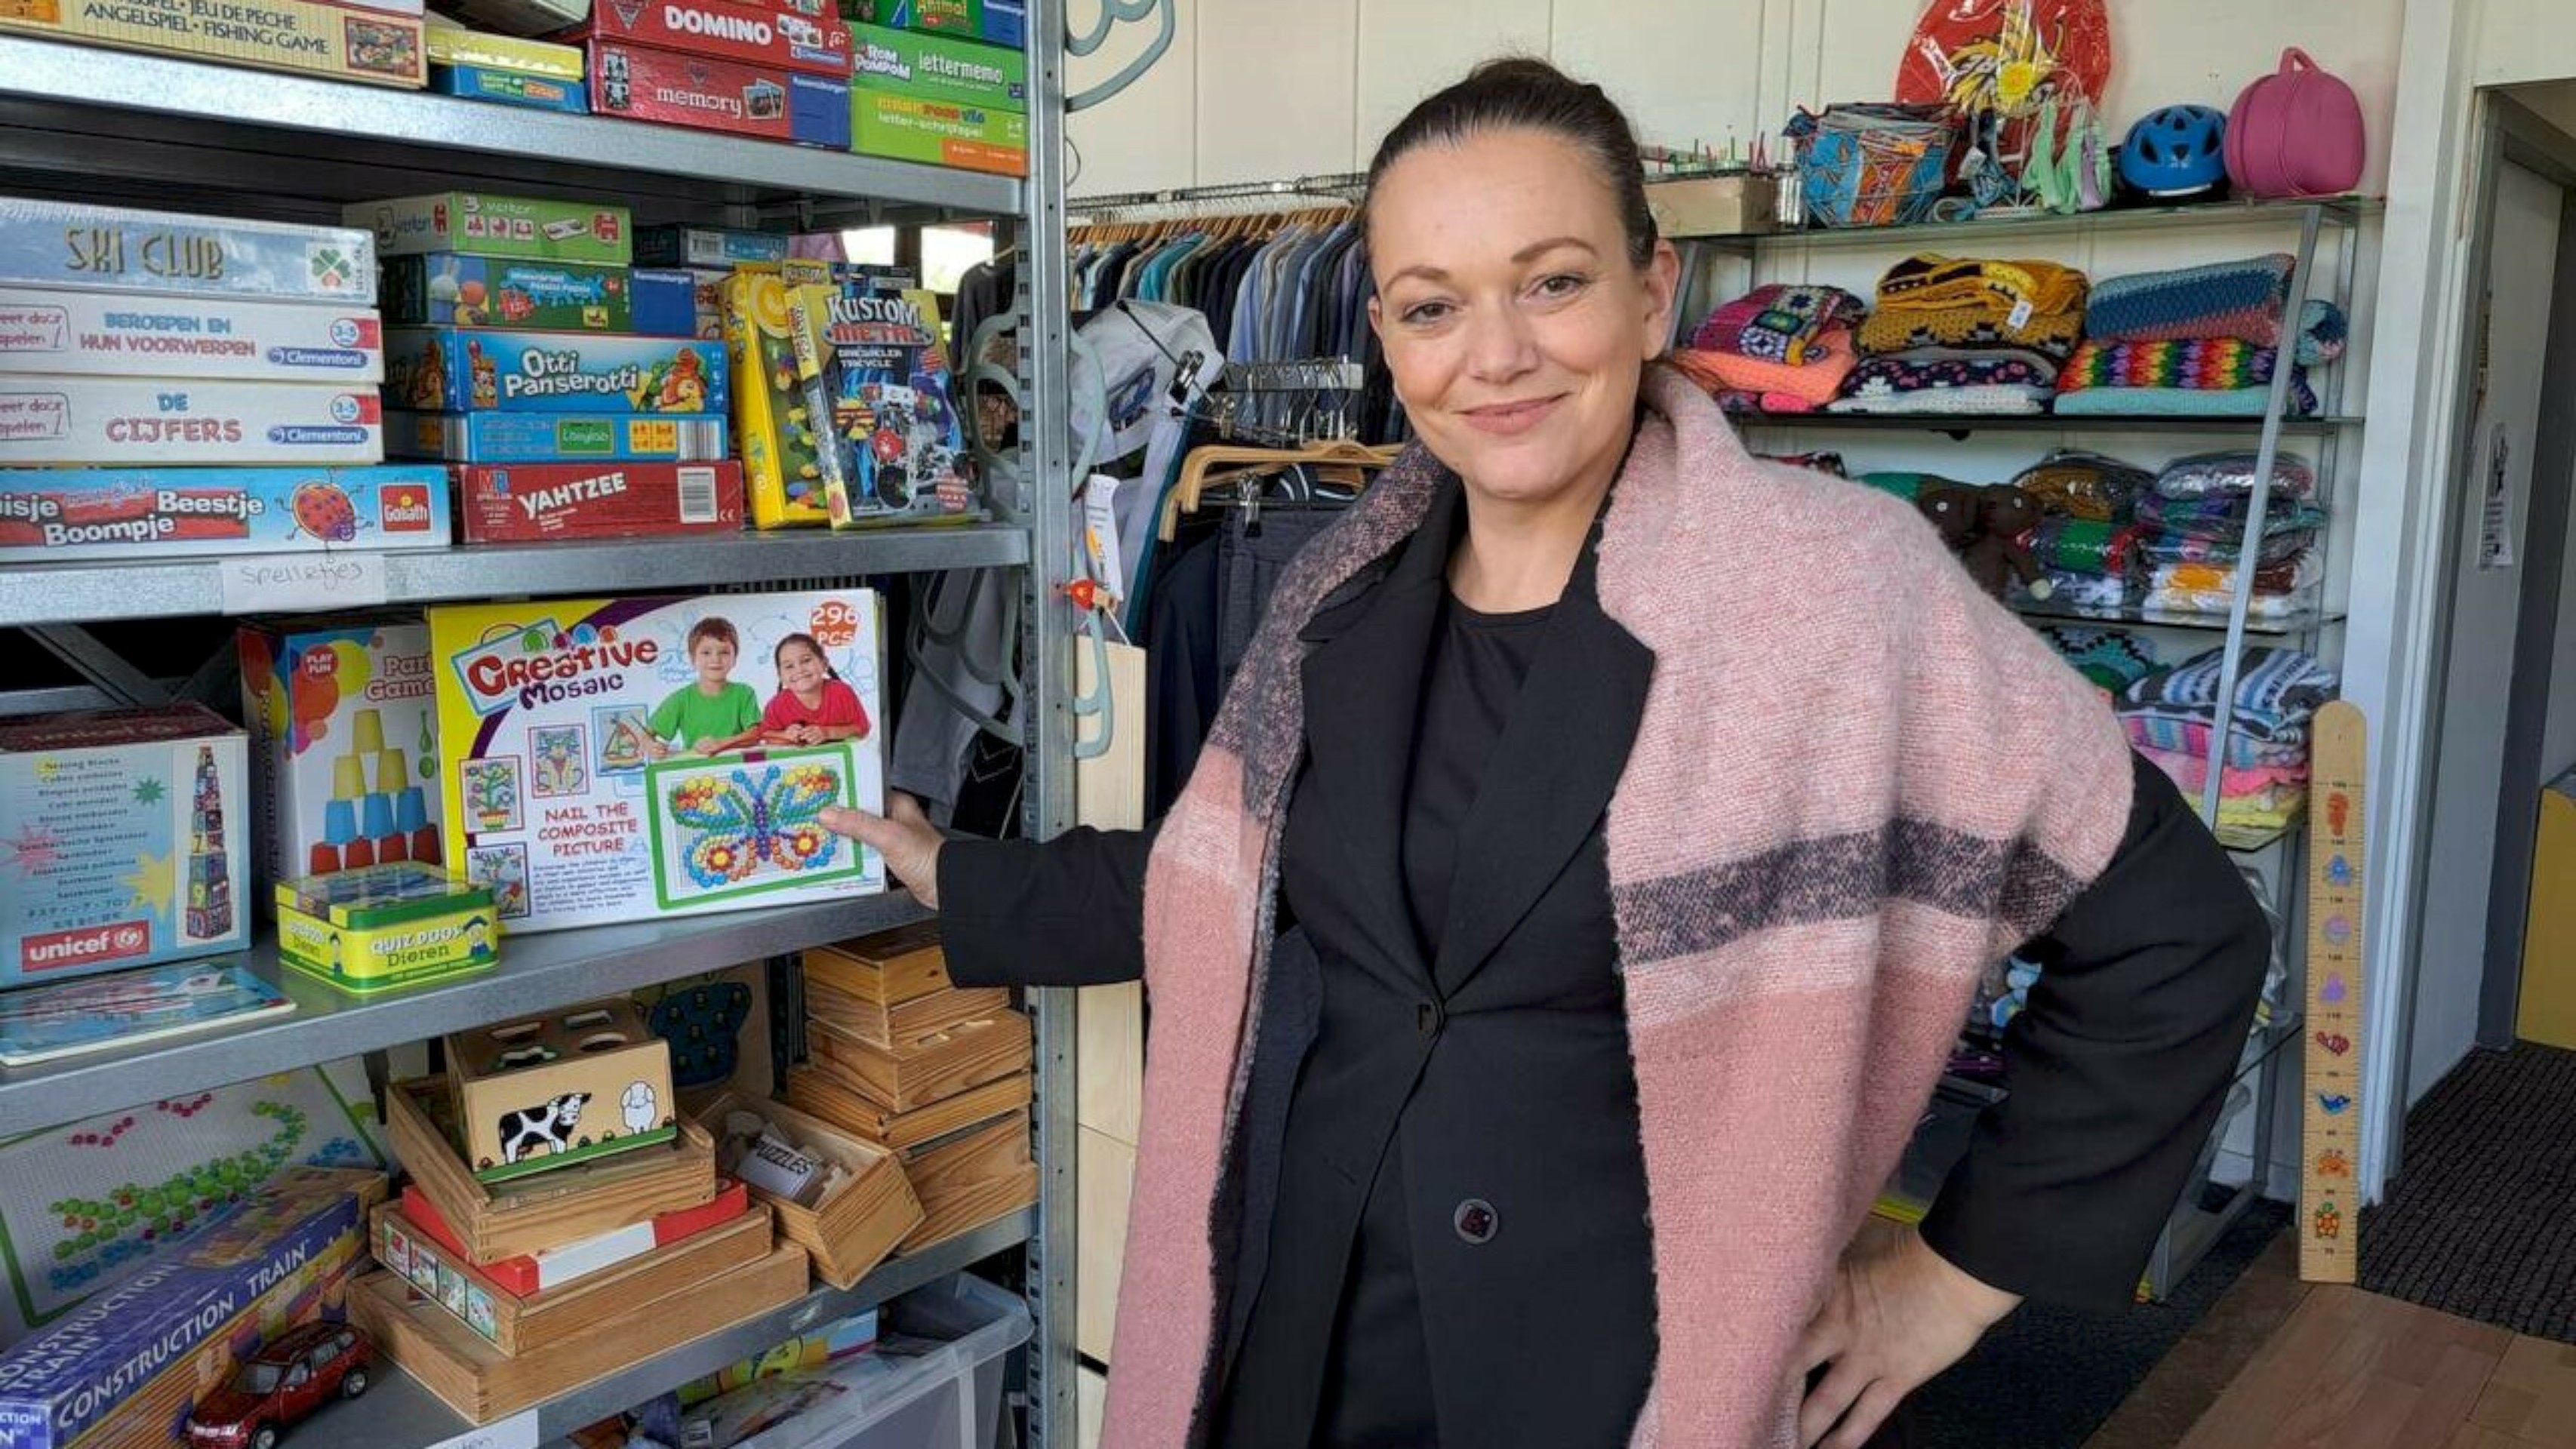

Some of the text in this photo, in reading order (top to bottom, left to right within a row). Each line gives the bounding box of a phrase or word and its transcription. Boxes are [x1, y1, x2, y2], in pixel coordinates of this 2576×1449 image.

[192, 0, 217, 17] JEU
[223, 6, 244, 21] DE
[665, 5, 771, 45] DOMINO
[84, 3, 330, 54] ANGELSPIEL FISHING GAME
[657, 88, 742, 118] memory
[66, 228, 224, 280] SKI CLUB
[104, 312, 231, 334] BEROEPEN EN
[826, 295, 921, 328] KUSTOM
[126, 336, 256, 356] VOORWERPEN
[523, 349, 578, 377] Otti
[504, 366, 638, 397] Panserotti
[157, 393, 189, 411] DE
[106, 417, 242, 442] CIJFERS
[157, 490, 264, 519] Beestje
[518, 471, 627, 521] YAHTZEE
[43, 514, 175, 546] Boompje
[809, 606, 859, 626] 296
[467, 639, 658, 697] Creative
[519, 674, 624, 709] Mosaic
[545, 801, 628, 821] NAIL THE
[538, 819, 637, 840] COMPOSITE
[553, 838, 623, 857] PICTURE
[29, 930, 111, 962] unicef
[386, 945, 450, 967] Dieren
[58, 1241, 306, 1429] CONSTRUCTION TRAIN
